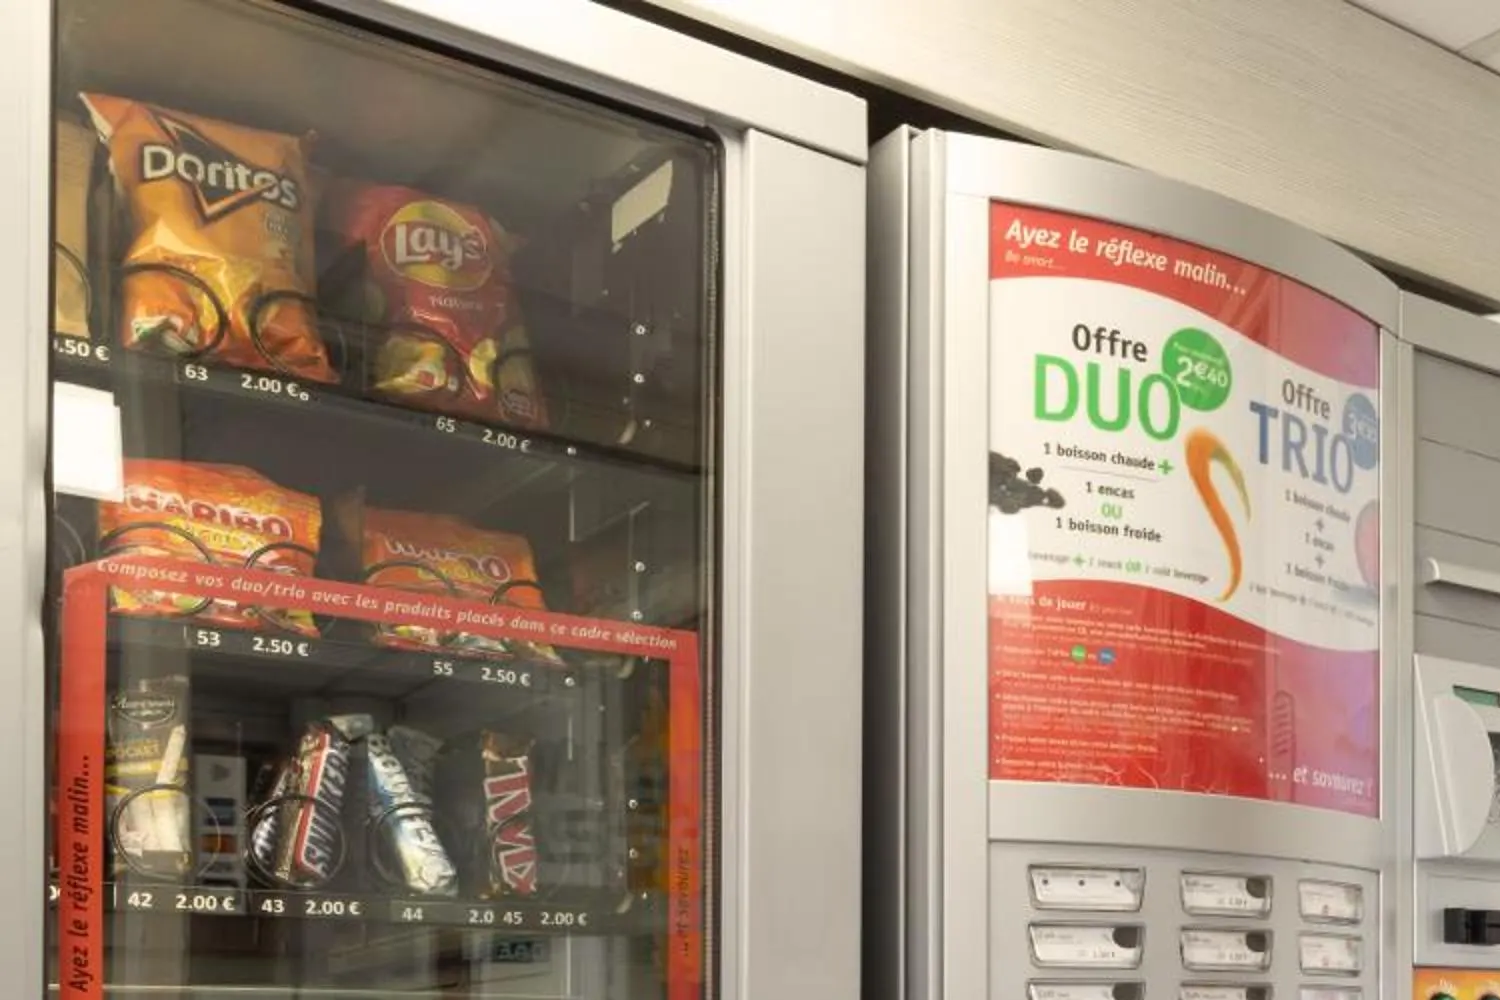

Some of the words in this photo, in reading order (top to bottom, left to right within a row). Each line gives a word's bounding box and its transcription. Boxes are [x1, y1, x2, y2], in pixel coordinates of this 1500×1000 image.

[142, 145, 298, 208] Doritos
[1005, 219, 1061, 248] Ayez
[1068, 229, 1089, 254] le
[1095, 238, 1168, 271] réflexe
[1173, 258, 1247, 297] malin...
[54, 341, 91, 358] .50
[96, 345, 110, 361] €
[1072, 323, 1148, 362] Offre
[185, 364, 209, 381] 63
[241, 374, 282, 395] 2.00
[285, 382, 300, 398] €
[1034, 353, 1181, 442] DUO
[1281, 379, 1331, 420] Offre
[436, 416, 457, 434] 65
[481, 429, 518, 451] 2.00
[520, 439, 532, 453] €
[1249, 401, 1354, 494] TRIO
[1044, 442, 1051, 455] 1
[1056, 444, 1108, 463] boisson
[1110, 451, 1155, 471] chaude
[1086, 481, 1092, 493] 1
[1097, 484, 1136, 500] encas
[1101, 503, 1123, 519] OU
[1056, 516, 1062, 529] 1
[1068, 518, 1119, 537] boisson
[1123, 524, 1162, 543] froide
[96, 560, 188, 585] Composez
[195, 573, 224, 588] vos
[231, 576, 306, 600] duo/trio
[312, 591, 351, 606] avec
[355, 592, 378, 610] les
[383, 600, 452, 623] produits
[456, 608, 505, 631] placés
[509, 615, 546, 634] dans
[551, 622, 566, 636] ce
[570, 625, 611, 642] cadre
[615, 626, 678, 650] sélection
[1055, 598, 1087, 611] jouer
[197, 629, 221, 647] 53
[252, 637, 293, 656] 2.50
[297, 643, 309, 658] €
[433, 661, 454, 677] 55
[481, 667, 518, 686] 2.50
[520, 673, 531, 688] €
[67, 754, 90, 835] malin...
[1293, 766, 1308, 785] et
[1312, 769, 1364, 795] savourez
[66, 843, 93, 912] réflexe
[128, 893, 153, 908] 42
[175, 895, 217, 911] 2.00
[222, 896, 235, 912] €
[261, 899, 285, 914] 43
[305, 900, 346, 916] 2.00
[349, 901, 361, 916] €
[401, 907, 423, 922] 44
[467, 909, 494, 924] 2.0
[503, 911, 523, 925] 45
[540, 911, 575, 926] 2.00
[578, 912, 588, 926] €
[66, 921, 89, 938] le
[69, 948, 95, 993] Ayez
